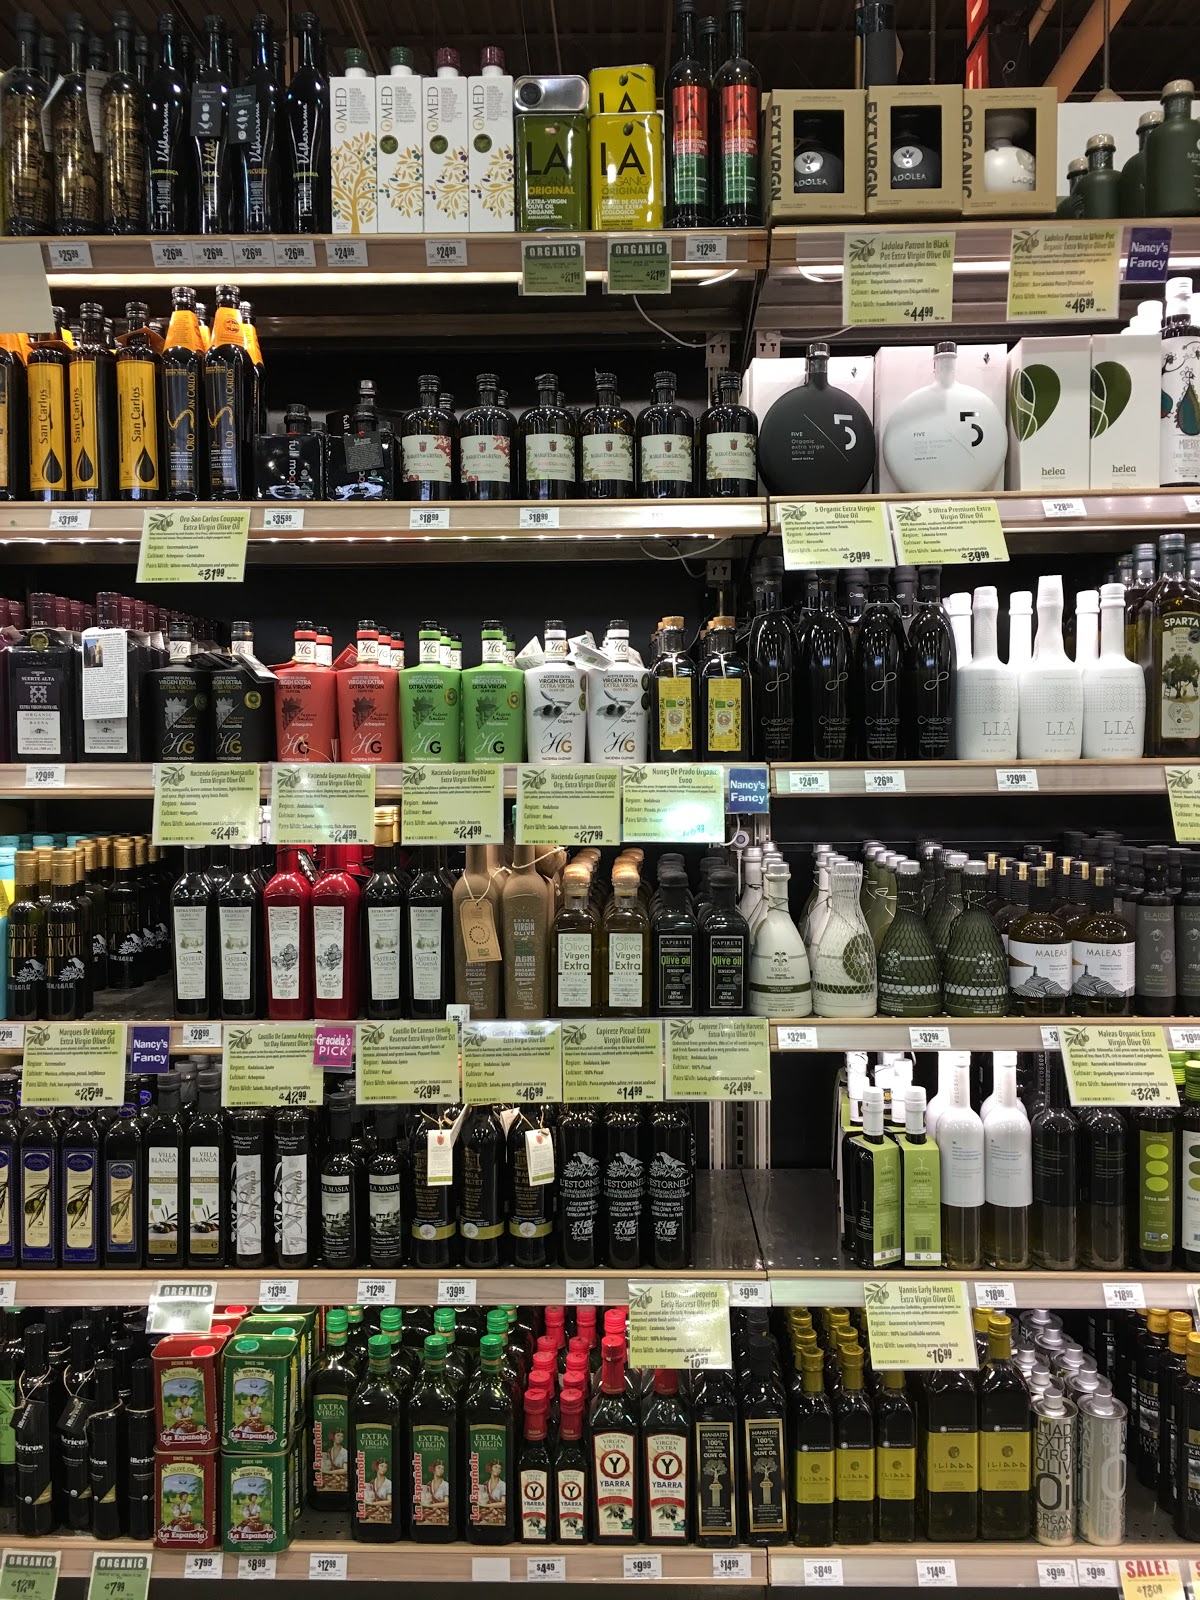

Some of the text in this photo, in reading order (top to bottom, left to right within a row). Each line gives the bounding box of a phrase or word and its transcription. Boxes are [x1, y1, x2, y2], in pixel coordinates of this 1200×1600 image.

[962, 105, 973, 199] ORGANIC
[526, 142, 570, 176] LA
[601, 143, 645, 176] LA
[528, 186, 575, 196] ORIGINAL
[616, 243, 664, 254] ORGANIC
[933, 241, 950, 249] Black
[1132, 242, 1168, 255] Nancy's
[530, 246, 581, 256] ORGANIC
[880, 251, 891, 260] Pot
[892, 251, 906, 260] Extra
[908, 251, 926, 261] Virgin
[927, 251, 942, 259] Olive
[1130, 257, 1166, 271] Fancy
[39, 389, 48, 444] San Carlos
[288, 440, 299, 457] full
[1041, 466, 1065, 476] helea
[198, 524, 216, 532] Virgin
[731, 780, 766, 792] Nancy's
[731, 792, 765, 804] Fancy
[564, 943, 589, 951] Oliva
[564, 952, 590, 960] Virgen
[1035, 949, 1068, 957] MALEAS
[1086, 948, 1122, 957] MALEAS
[661, 955, 690, 965] Olive oil
[564, 962, 590, 970] Extra
[59, 1028, 81, 1036] Marques
[637, 1027, 650, 1035] Extra
[75, 1037, 91, 1046] Virgin
[92, 1036, 105, 1044] Olive
[134, 1039, 168, 1049] Nancy's
[316, 1033, 350, 1046] Graciela's
[604, 1036, 621, 1045] Virgin
[1107, 1038, 1125, 1047] Virgin
[319, 1047, 347, 1056] PICK
[134, 1053, 167, 1064] Fancy
[164, 1287, 208, 1296] ORGANIC
[173, 1433, 208, 1442] Española
[242, 1431, 274, 1441] Española
[356, 1504, 366, 1518] La
[9, 1556, 53, 1567] ORGANIC
[100, 1558, 144, 1568] ORGANIC
[1126, 1560, 1169, 1578] SALE!
